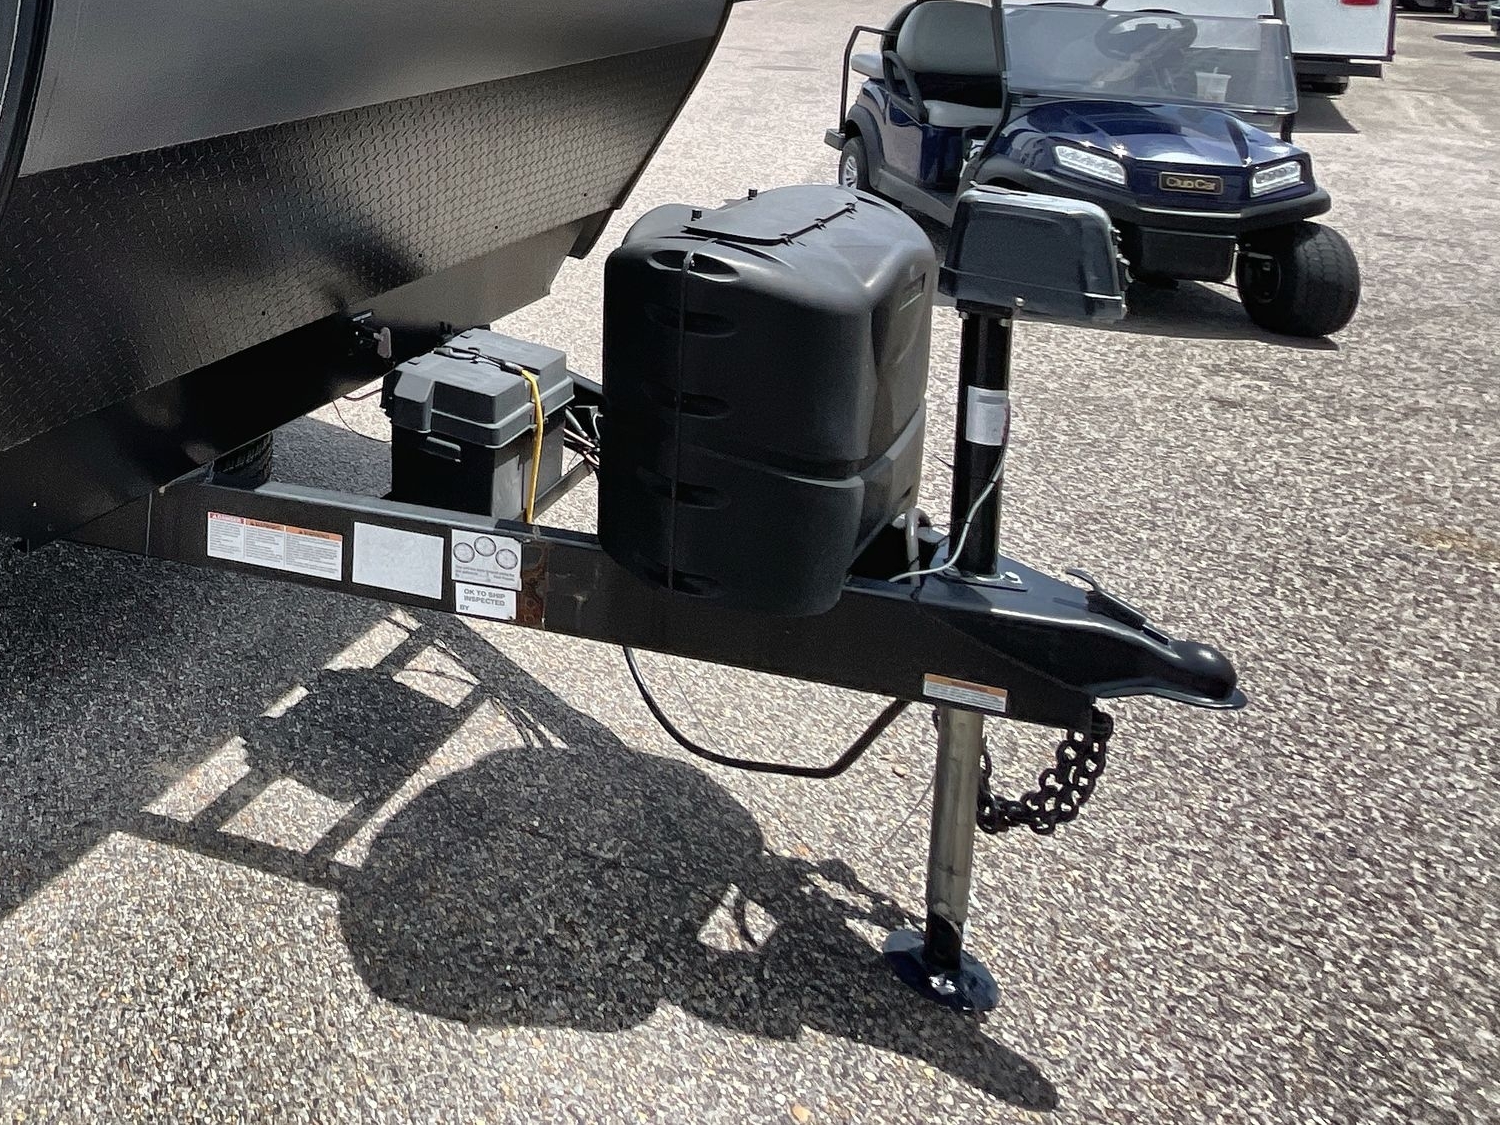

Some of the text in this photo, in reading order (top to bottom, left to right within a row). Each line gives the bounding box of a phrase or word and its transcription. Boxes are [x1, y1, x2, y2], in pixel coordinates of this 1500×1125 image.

[1166, 177, 1216, 190] Club Car
[463, 595, 505, 606] INSPECTED
